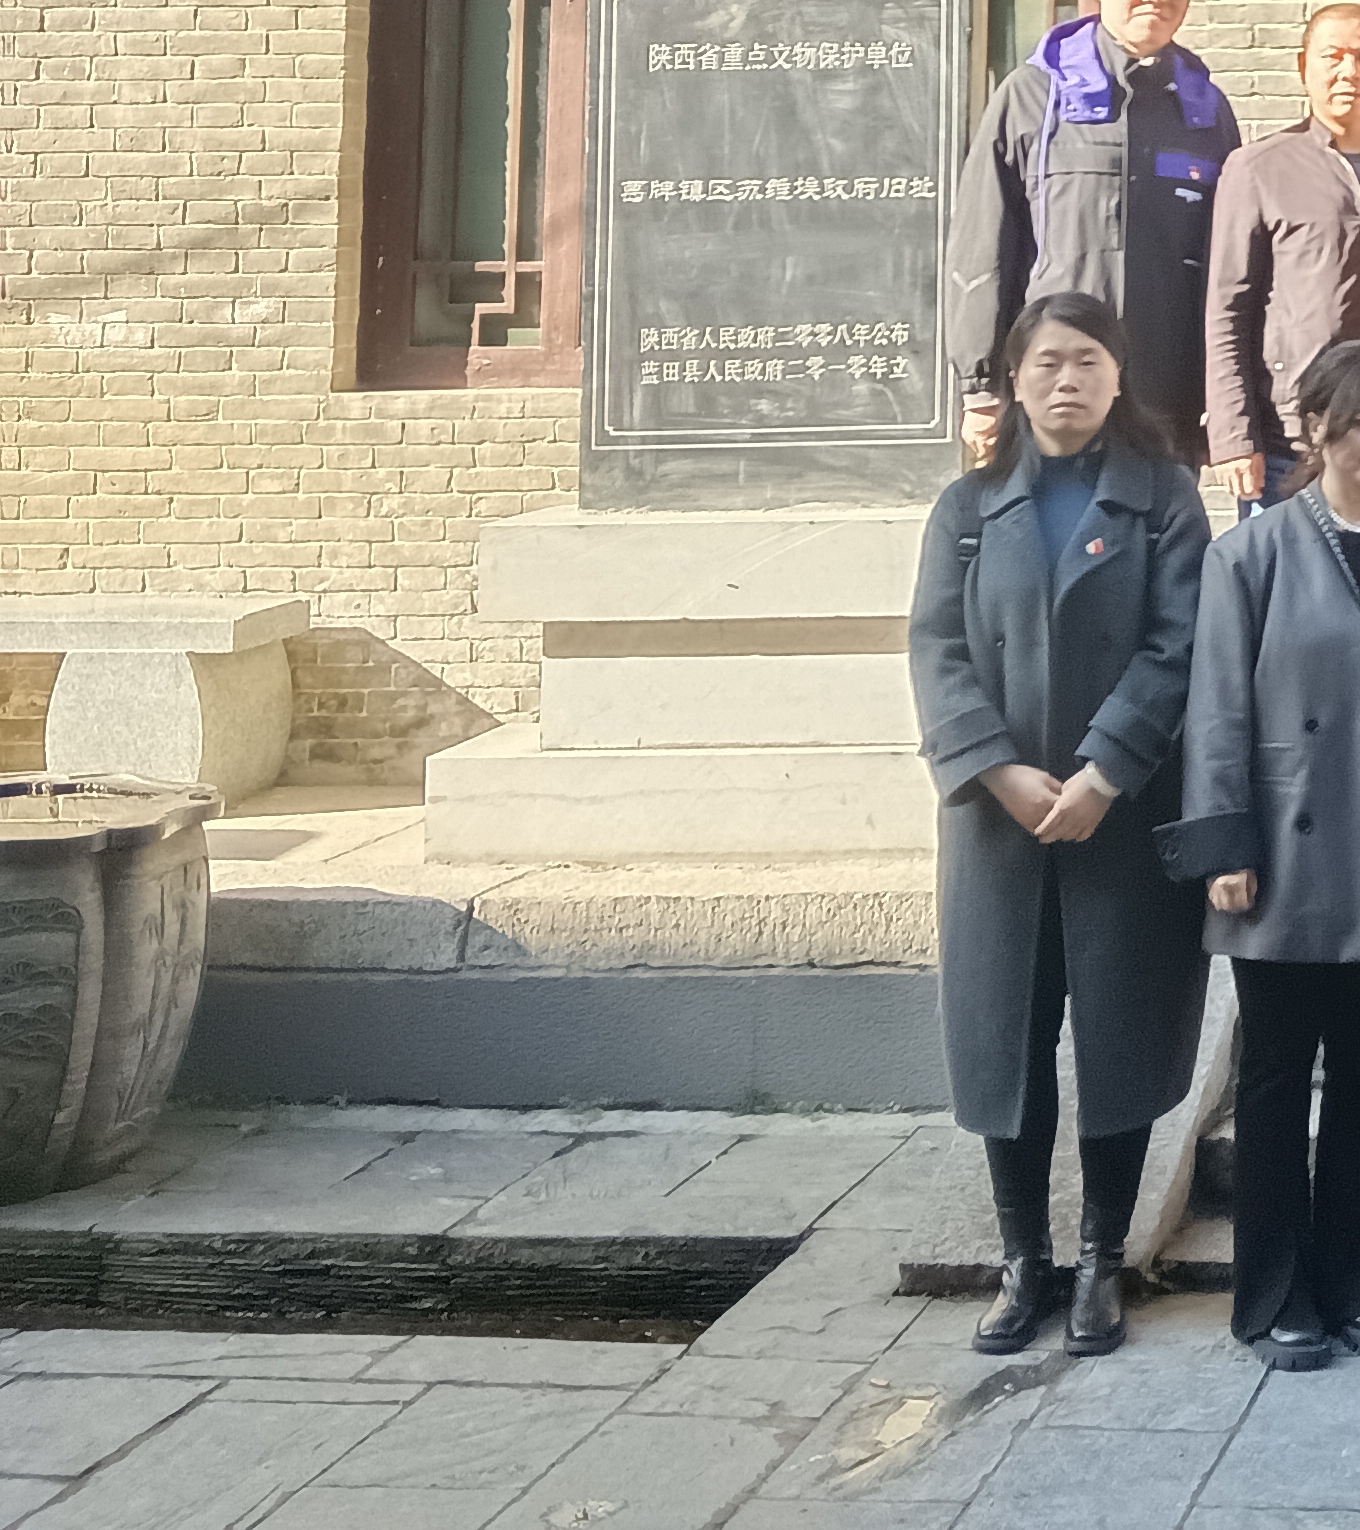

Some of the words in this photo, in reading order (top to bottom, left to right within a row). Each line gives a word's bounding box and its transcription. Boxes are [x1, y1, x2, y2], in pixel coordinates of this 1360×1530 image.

[648, 40, 914, 72] 陕西省重点文物保护单位
[619, 175, 937, 203] 葛牌镇区苏维埃政府旧址
[639, 322, 910, 354] 陕西省人民政府二零零八年公布
[640, 354, 910, 385] 蓝田县人民政府二零一零年立
